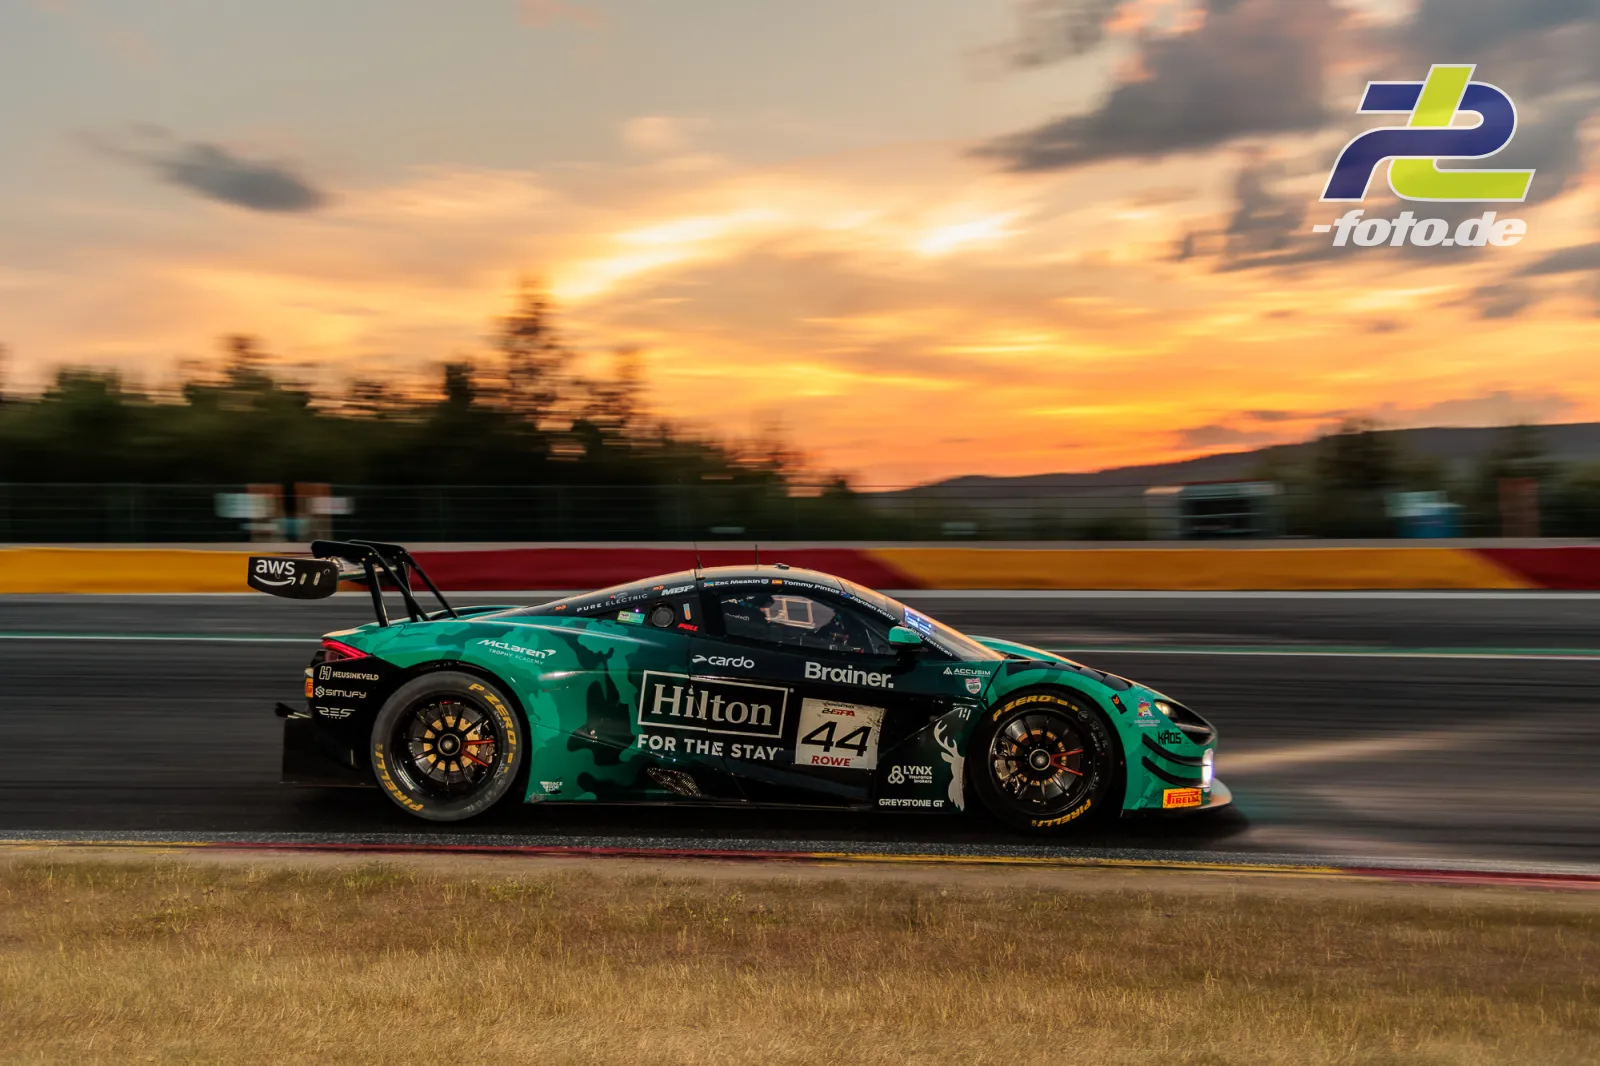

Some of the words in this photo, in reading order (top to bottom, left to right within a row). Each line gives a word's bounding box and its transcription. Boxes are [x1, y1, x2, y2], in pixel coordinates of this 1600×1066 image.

[255, 559, 296, 576] aws
[783, 579, 813, 589] Tommy
[814, 584, 840, 595] Pintos
[576, 602, 602, 612] PURE
[605, 593, 648, 606] ELECTRIC
[850, 594, 877, 611] Jayden
[876, 608, 896, 621] Kelly
[677, 622, 699, 631] PULL
[476, 639, 546, 659] McLaren
[489, 648, 513, 658] TROPHY
[514, 654, 544, 665] ACADEMY
[708, 656, 755, 669] cardo
[332, 670, 380, 681] HEUSINKVELD
[804, 661, 894, 689] Brainer.
[953, 668, 991, 676] ACCUSIM
[651, 683, 772, 727] Hilton
[1004, 695, 1052, 712] ZERO
[637, 734, 676, 751] FOR
[684, 738, 723, 756] THE
[801, 721, 872, 757] 44
[811, 755, 851, 767] ROWE
[903, 765, 932, 775] LYNX
[375, 752, 424, 811] PIRELLI
[879, 798, 931, 807] GREYSTONE
[933, 800, 944, 808] GT
[1037, 799, 1092, 827] PIRELLI
